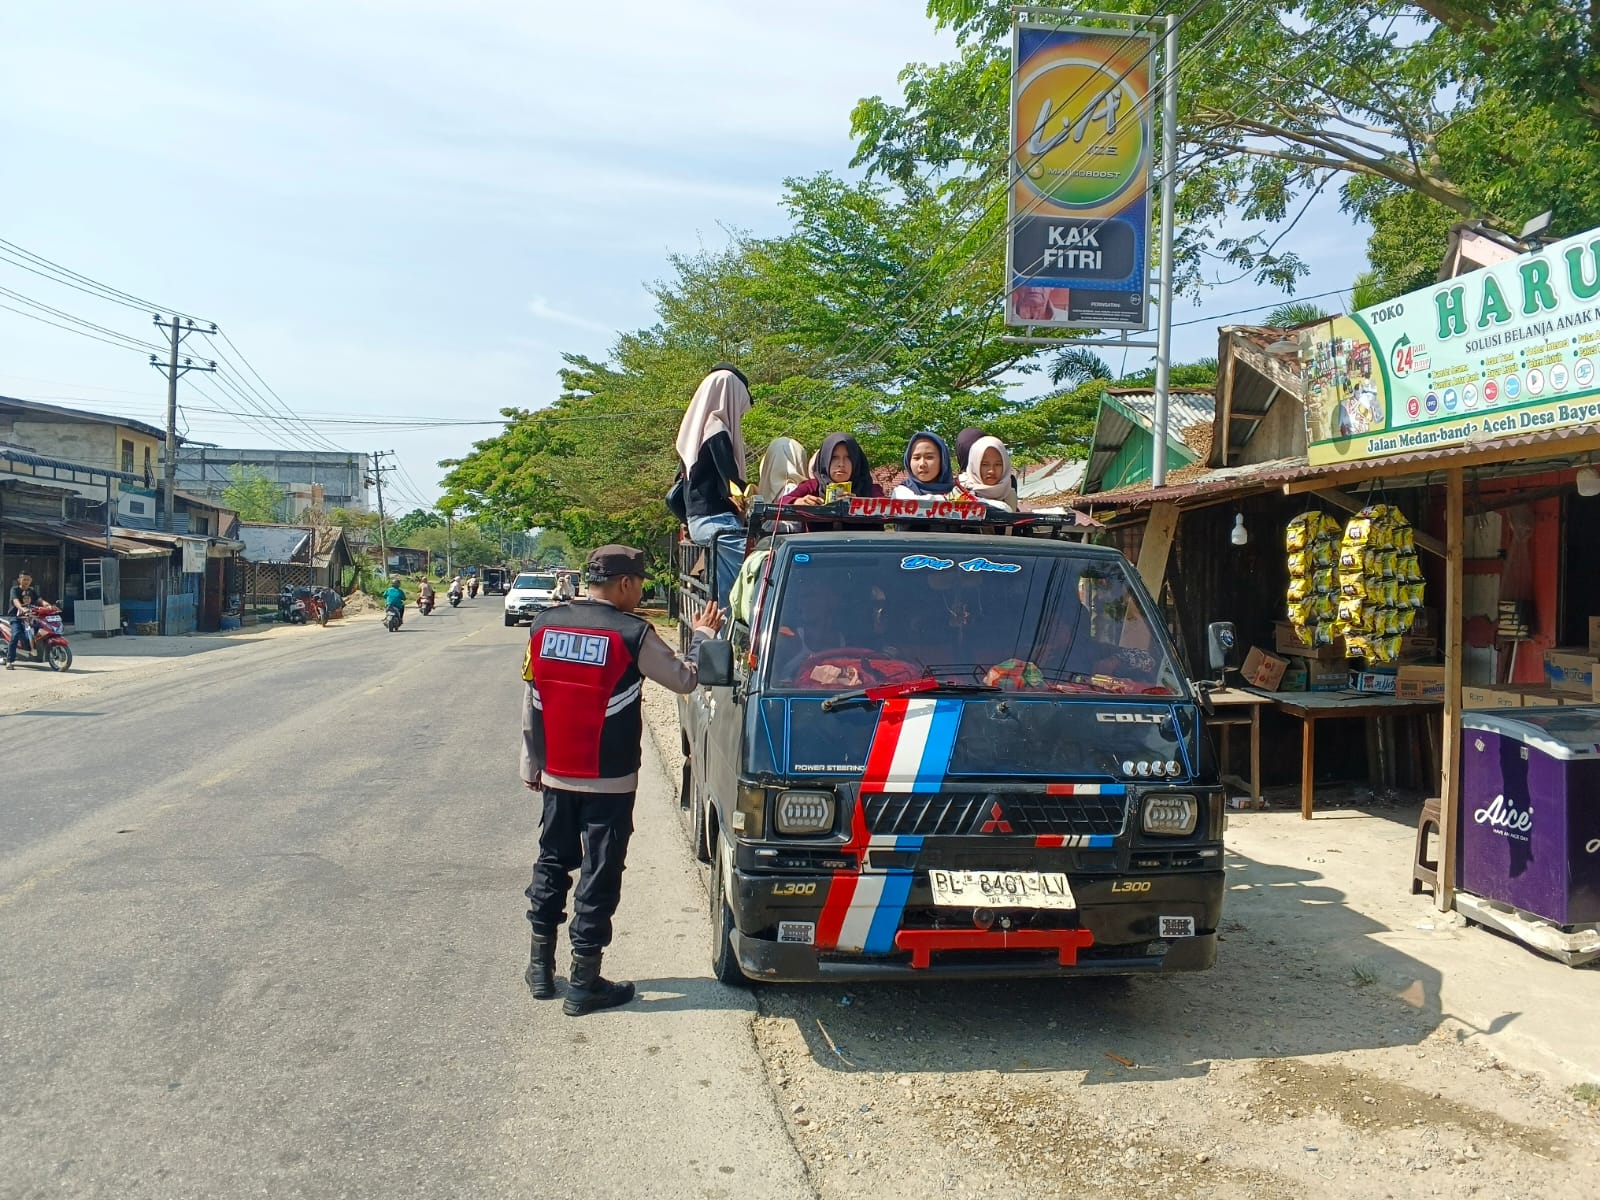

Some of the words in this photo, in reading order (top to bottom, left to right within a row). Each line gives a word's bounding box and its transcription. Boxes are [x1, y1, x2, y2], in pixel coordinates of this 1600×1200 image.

[1048, 226, 1100, 247] KAK
[1044, 248, 1102, 270] FITRI
[1371, 303, 1404, 325] TOKO
[1465, 334, 1502, 354] SOLUSI
[1504, 321, 1554, 343] BELANJA
[1556, 310, 1592, 330] ANAK
[1397, 346, 1414, 373] 24
[1368, 437, 1397, 452] Jalan
[1483, 415, 1517, 434] Aceh
[1519, 410, 1555, 428] Desa
[850, 498, 920, 517] PUTRO
[543, 632, 606, 663] POLISI
[1096, 712, 1165, 723] COLT
[826, 764, 866, 772] STEERING
[1474, 794, 1534, 831] Aice
[772, 883, 817, 896] L300
[935, 872, 964, 895] BL
[1042, 875, 1065, 895] LV
[1111, 881, 1152, 893] L300
